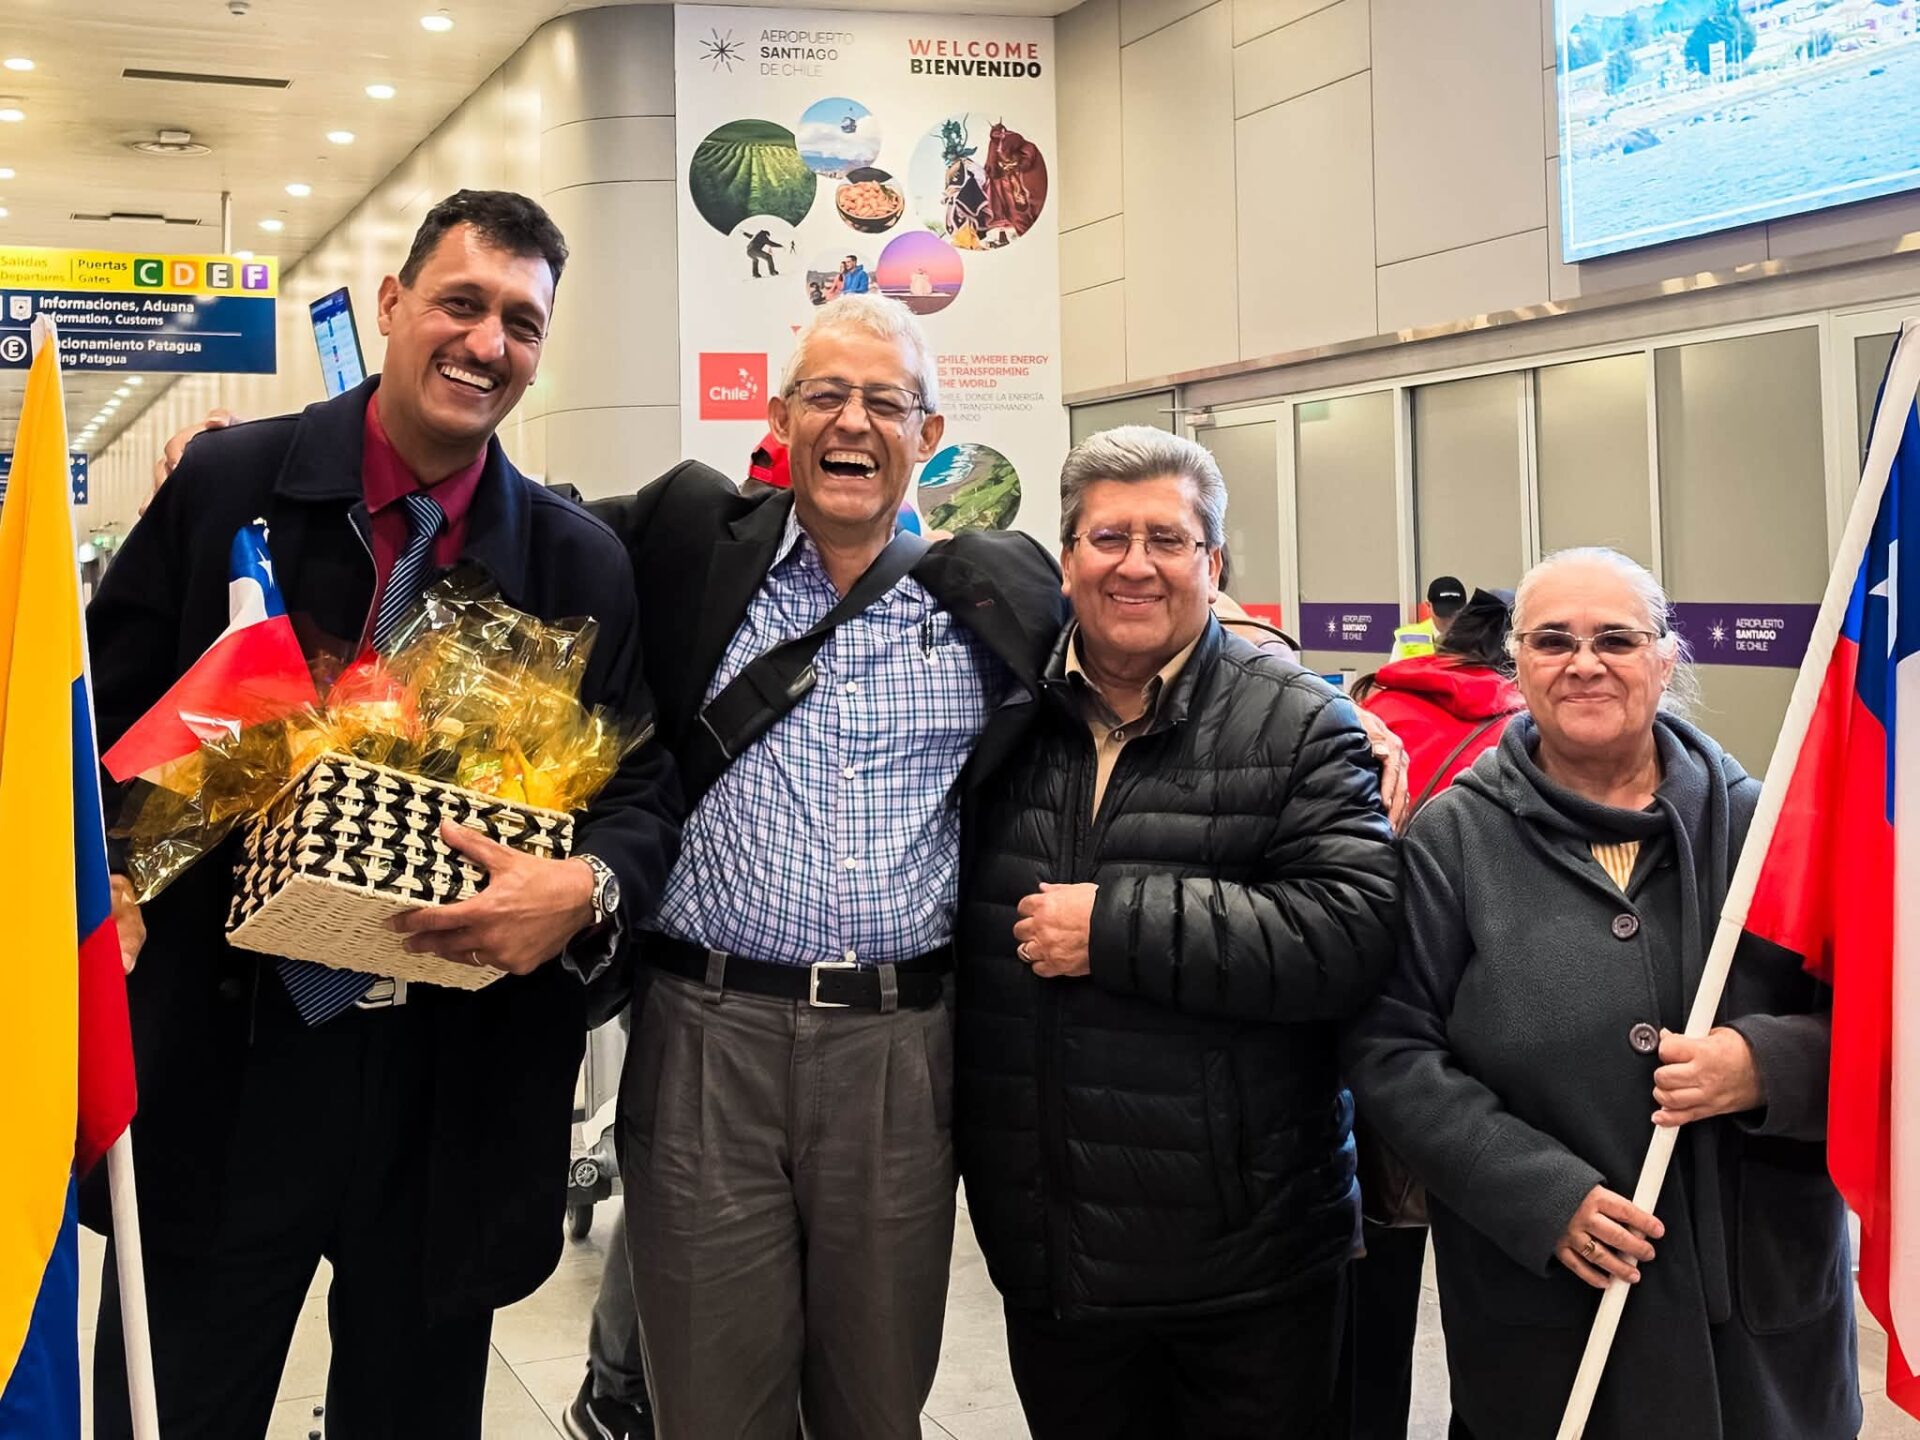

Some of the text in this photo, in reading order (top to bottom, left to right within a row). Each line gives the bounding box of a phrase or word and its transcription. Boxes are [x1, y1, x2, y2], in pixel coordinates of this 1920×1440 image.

[760, 29, 855, 45] AEROPUERTO
[760, 46, 838, 61] SANTIAGO
[908, 39, 1038, 59] WELCOME
[760, 63, 824, 77] DE CHILE
[910, 58, 1042, 78] BIENVENIDO
[0, 255, 48, 267] Salidas
[78, 259, 128, 271] Puertas
[0, 271, 65, 282] Departures
[78, 274, 111, 284] Gates
[139, 262, 263, 288] C D E F
[39, 296, 195, 313] Informaciones, Aduana
[115, 313, 164, 326] Customs
[147, 339, 202, 354] Patagua
[80, 353, 127, 366] Patagua
[970, 355, 1010, 365] WHERE
[1010, 355, 1049, 366] ENERGY
[951, 367, 1030, 377] TRANSFORMING
[959, 379, 998, 388] WORLD
[709, 386, 750, 401] Chile
[1735, 618, 1785, 629] AEROPUERTO
[1735, 629, 1777, 640] SANTIAGO
[1735, 640, 1768, 651] DE CHILE
